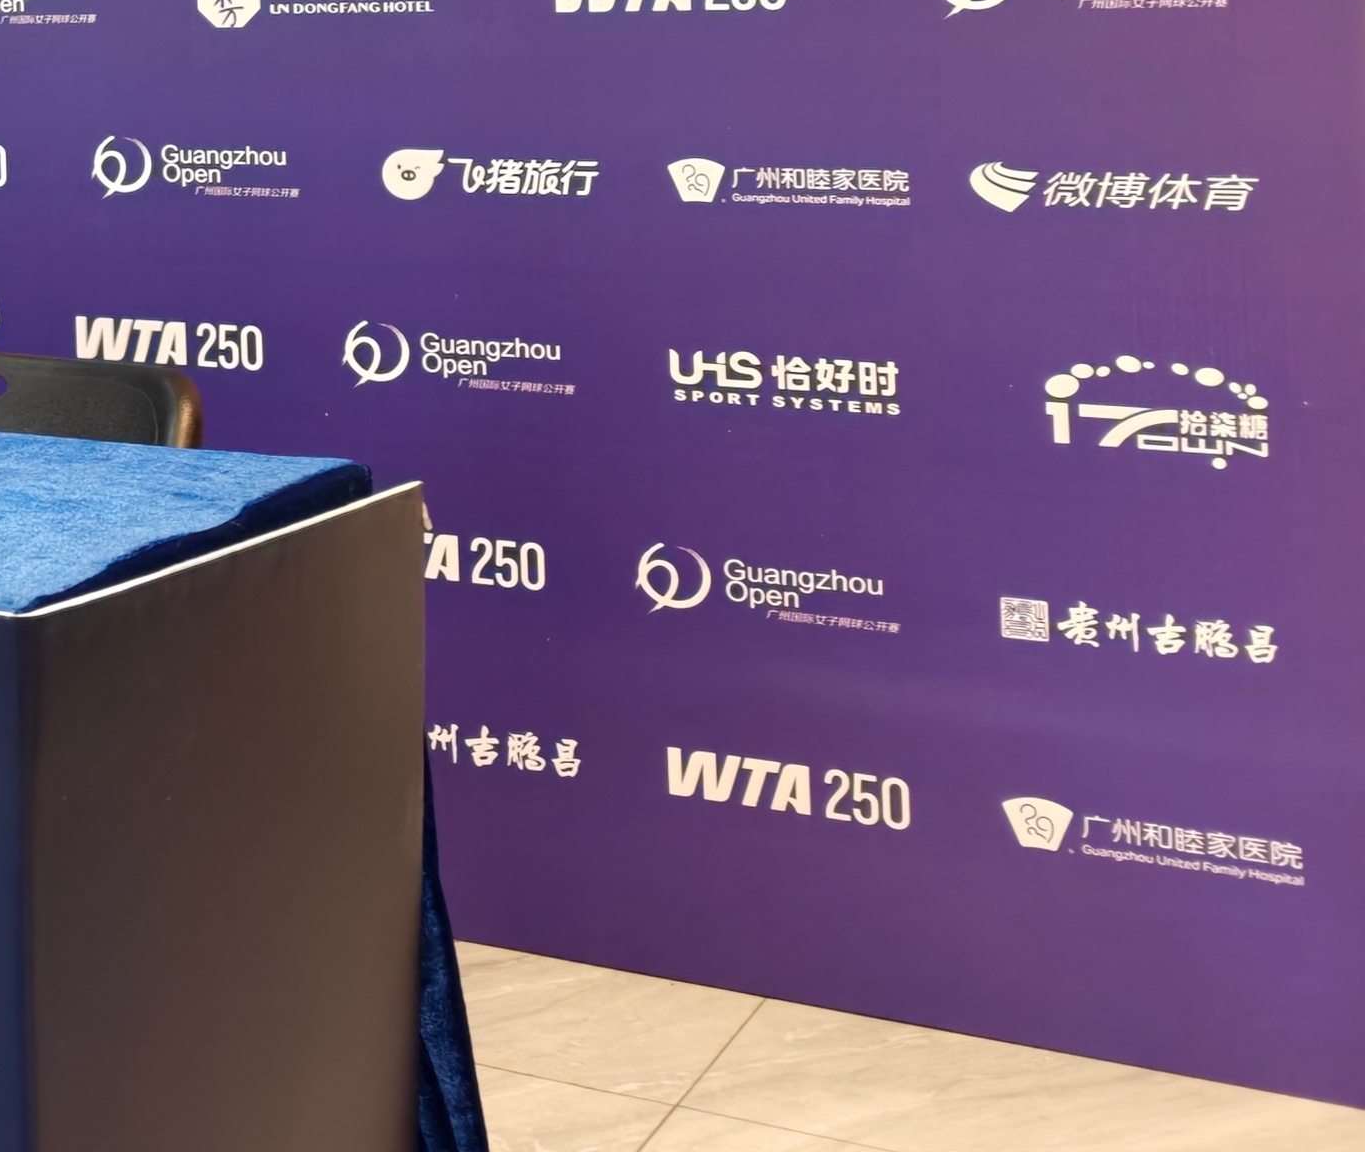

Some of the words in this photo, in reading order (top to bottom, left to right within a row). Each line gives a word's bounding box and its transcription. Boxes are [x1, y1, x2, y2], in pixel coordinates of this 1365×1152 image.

[292, 1, 381, 15] DONGFANG
[383, 0, 435, 13] HOTEL
[161, 145, 287, 169] Guangzhou
[162, 163, 220, 188] Open
[447, 157, 600, 196] 飞猪旅行
[731, 167, 910, 192] 广州和睦家医院
[1042, 171, 1260, 211] 微博体育
[731, 192, 791, 205] Guangzhou
[791, 194, 828, 204] United
[829, 194, 865, 207] Family
[865, 196, 911, 207] Hospital
[75, 315, 188, 366] WTA
[196, 322, 264, 371] 250
[420, 332, 561, 363] Guangzhou
[422, 353, 487, 381] Open
[668, 348, 763, 389] UHS
[771, 354, 899, 397] 恰好时
[674, 389, 760, 406] SPORT
[772, 395, 901, 416] SYSTEMS
[470, 536, 546, 591] 250
[724, 558, 883, 596] Guangzhou
[725, 583, 799, 612] Open
[666, 746, 812, 816] WTA
[823, 768, 911, 830] 250
[1081, 814, 1305, 870] 广州和睦家医院
